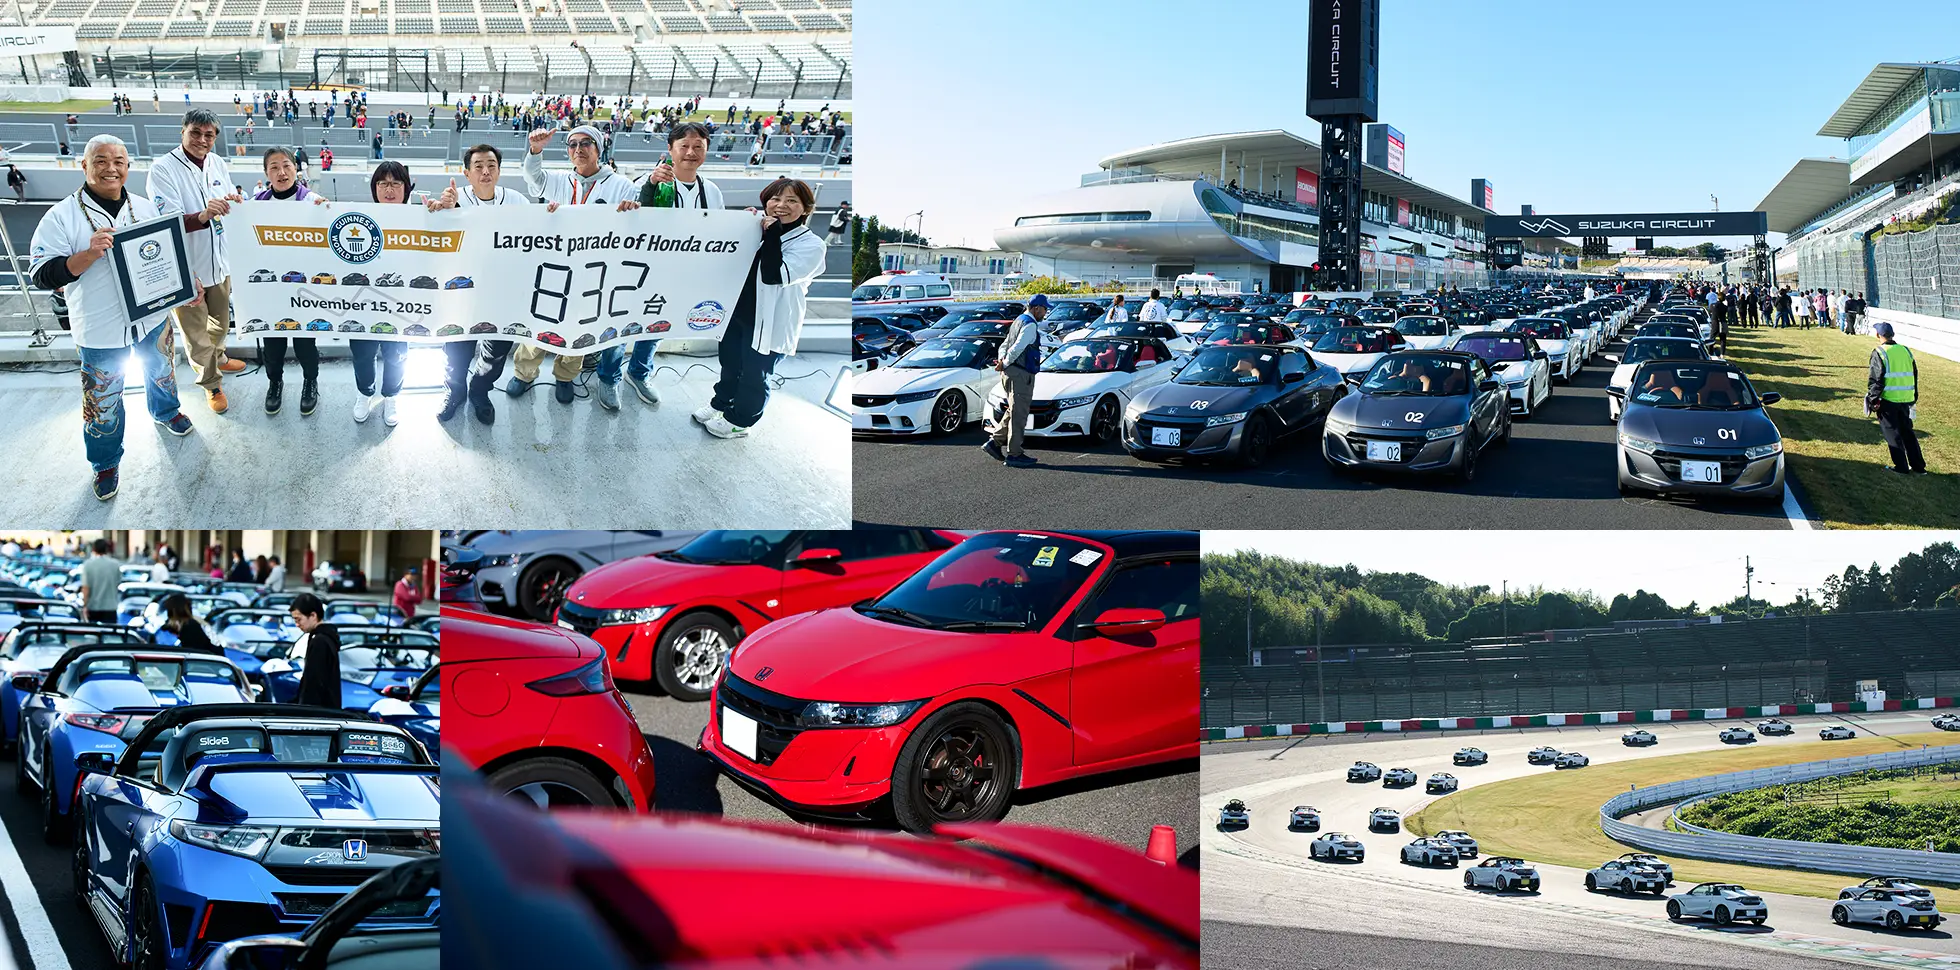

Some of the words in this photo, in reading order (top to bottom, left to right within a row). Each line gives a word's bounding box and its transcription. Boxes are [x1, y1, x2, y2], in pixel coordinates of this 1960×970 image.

[0, 36, 45, 47] IRCUIT
[1330, 24, 1340, 89] CIRCUIT
[335, 216, 375, 230] GUINNESS
[1578, 220, 1645, 230] SUZUKA
[1650, 219, 1716, 229] CIRCUIT
[264, 230, 324, 243] RECORD
[387, 234, 453, 248] HOLDER
[493, 231, 563, 253] Largest
[567, 231, 620, 256] parade
[623, 233, 647, 250] of
[648, 234, 701, 253] Honda
[704, 239, 740, 253] cars
[332, 235, 351, 260] WORLD
[353, 236, 380, 261] RECORDS
[530, 260, 650, 325] 832
[643, 293, 667, 316] 台
[290, 296, 367, 312] November
[370, 301, 392, 314] 15,
[396, 302, 432, 315] 2025
[1190, 400, 1209, 410] 03
[1404, 412, 1425, 423] 02
[1168, 429, 1180, 446] 03
[1717, 428, 1738, 441] 01
[1386, 446, 1400, 461] 02
[1705, 466, 1719, 482] 01
